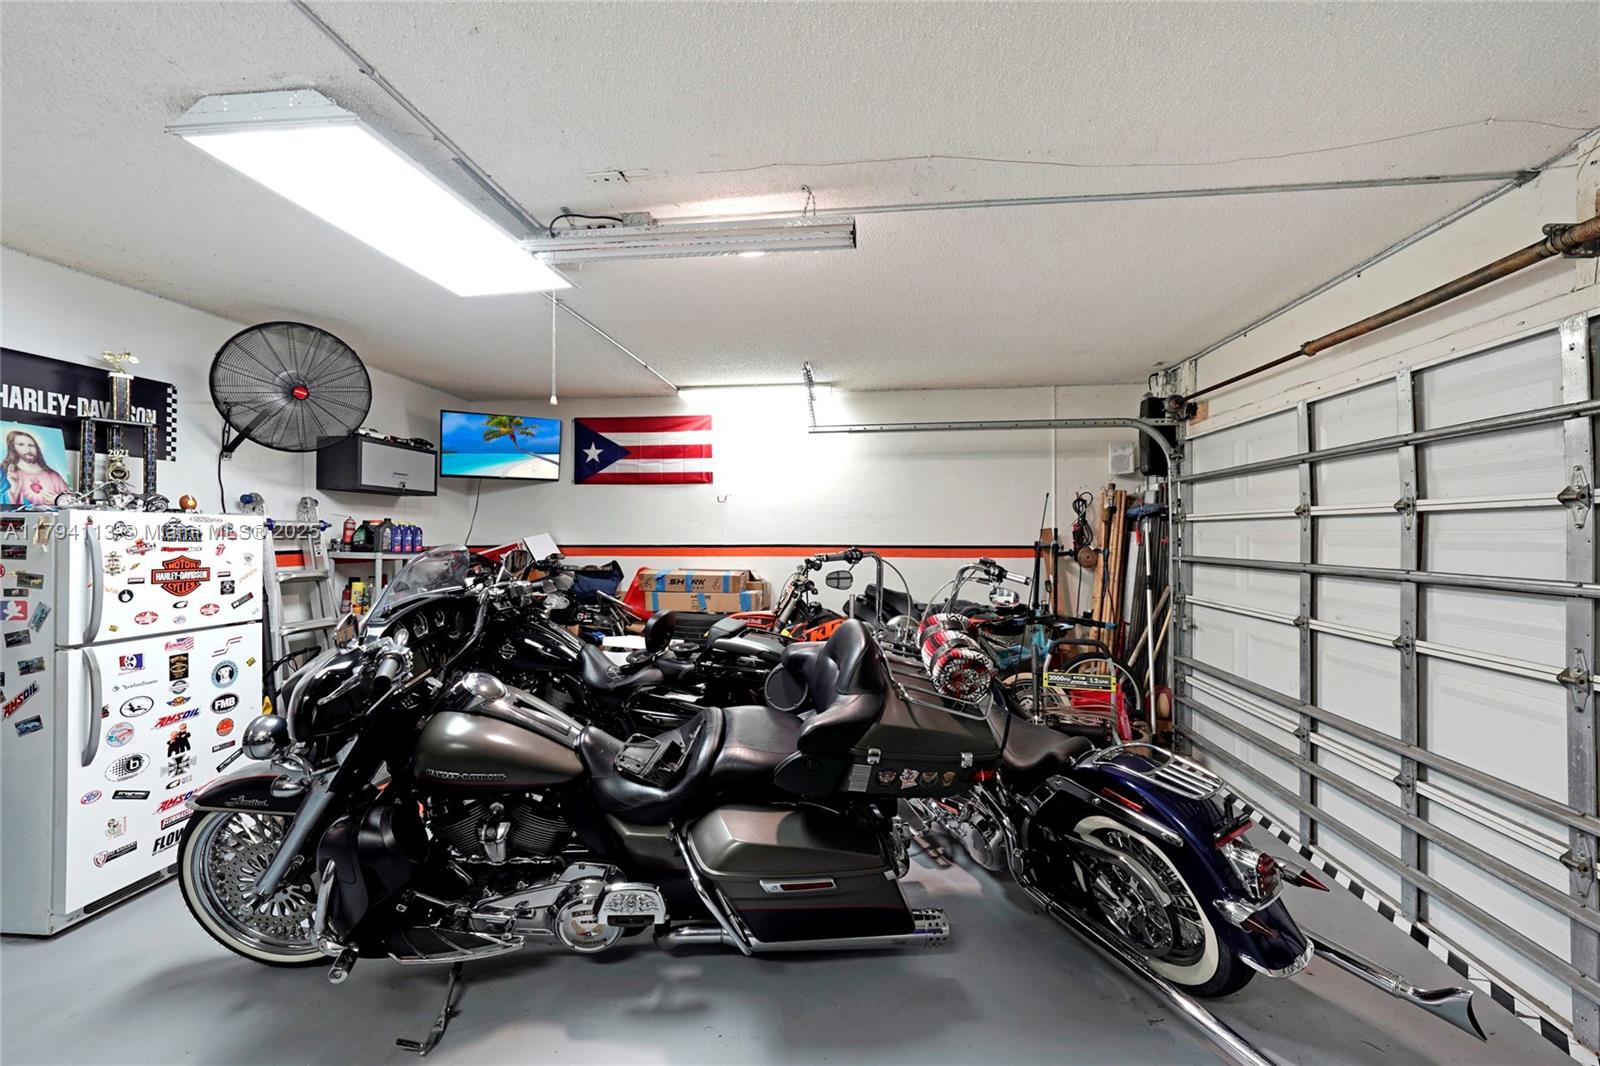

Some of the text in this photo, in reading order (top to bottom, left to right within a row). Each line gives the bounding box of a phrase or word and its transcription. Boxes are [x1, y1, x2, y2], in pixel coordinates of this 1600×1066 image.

[0, 383, 157, 424] HARLEY-DAVSON
[108, 449, 129, 457] 2021
[168, 560, 197, 569] MOTOR
[167, 581, 197, 593] CYCLES
[669, 578, 706, 586] SHRK
[2, 681, 39, 719] AMSOIL
[214, 697, 236, 711] FMB
[154, 707, 201, 729] AMSOIL
